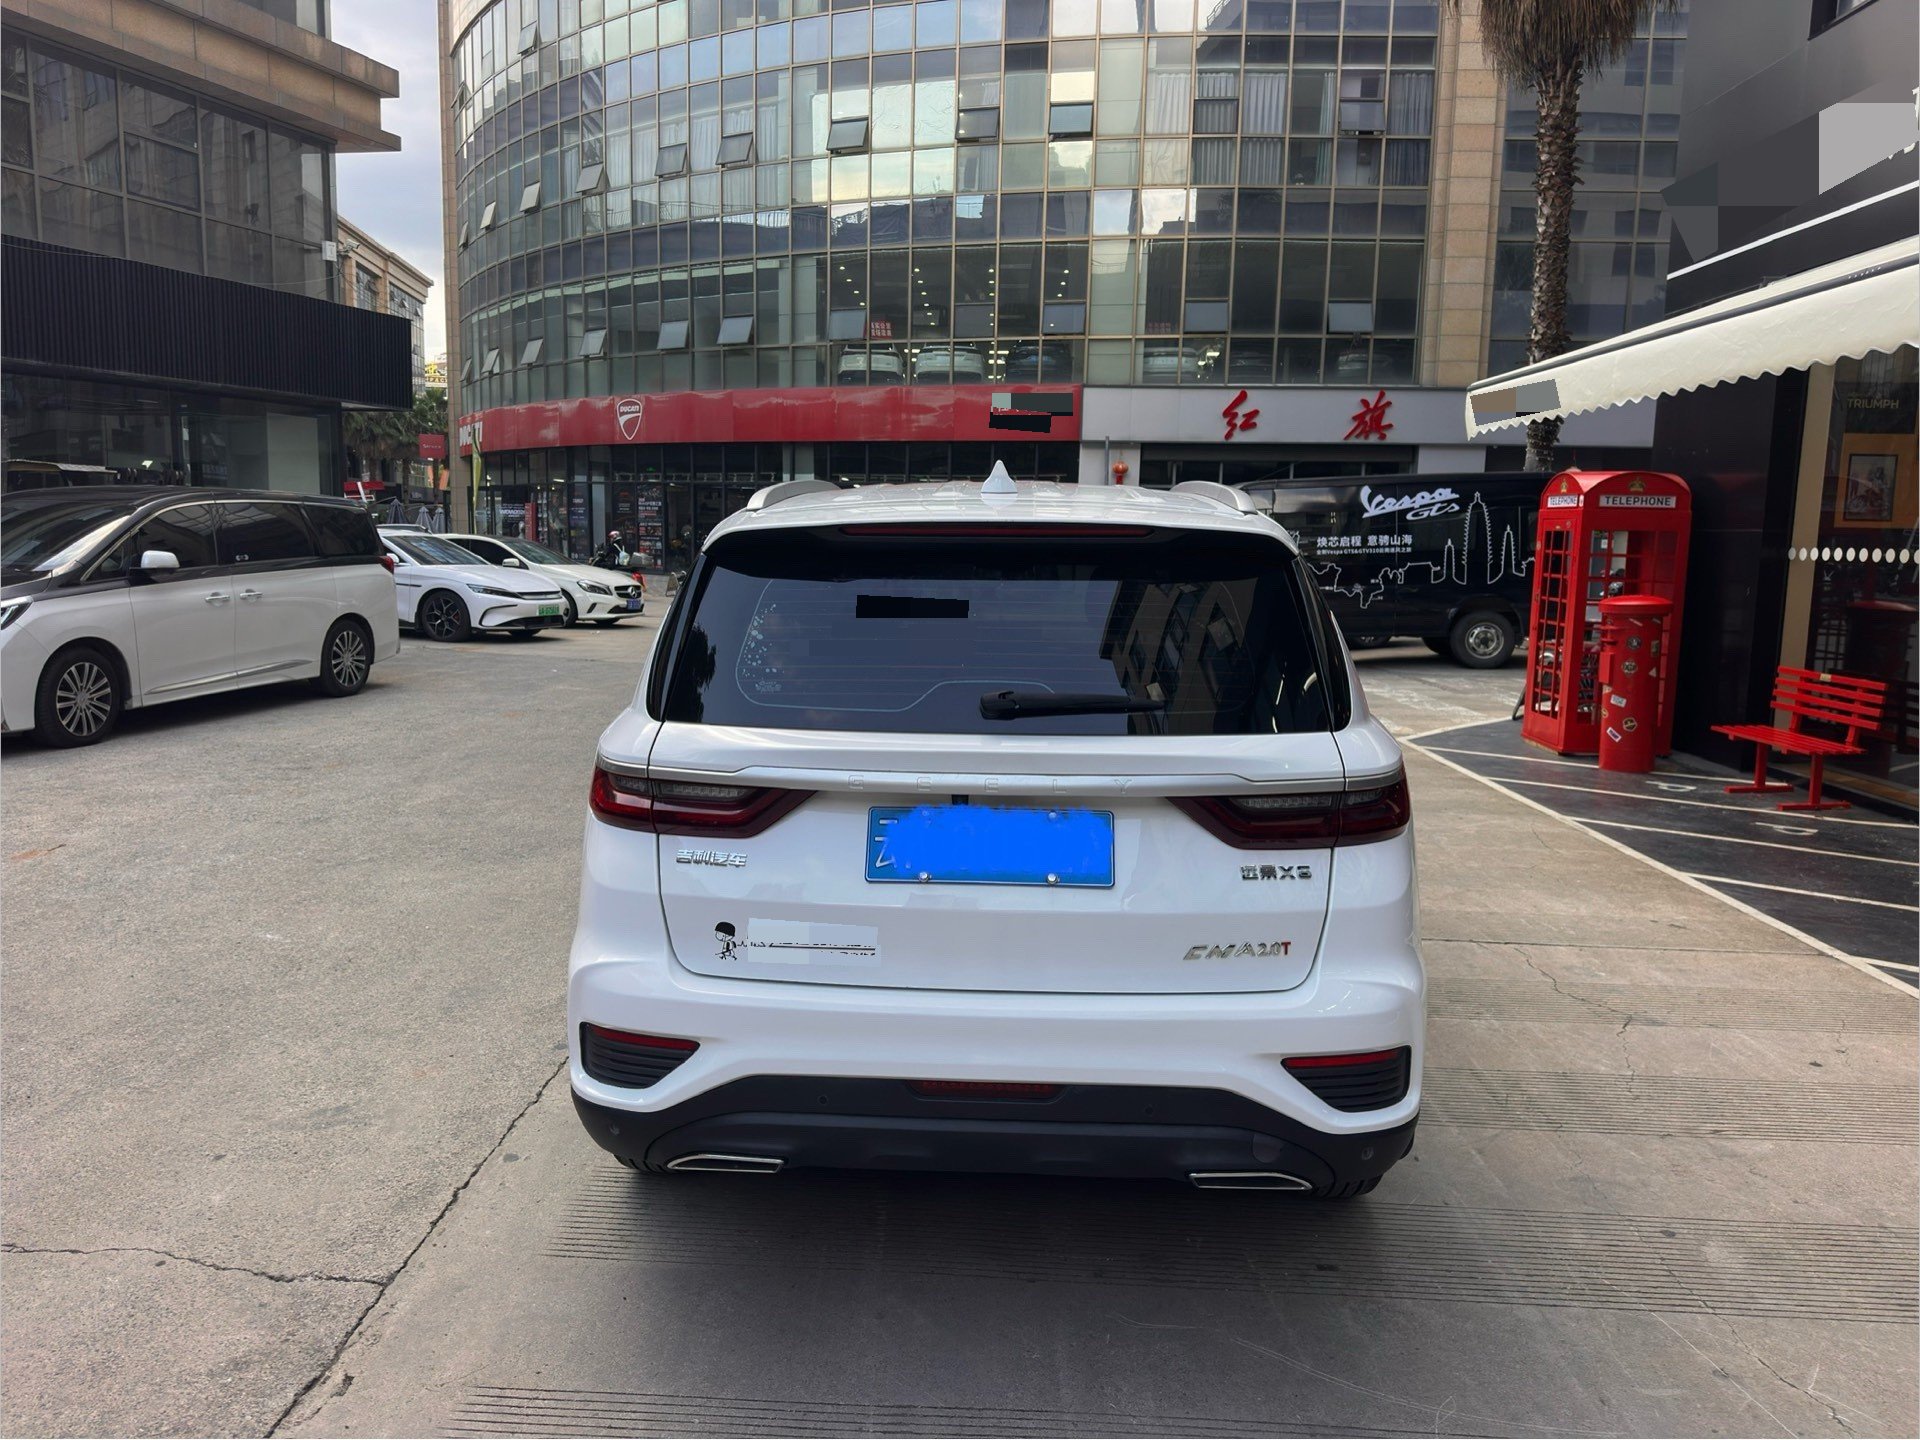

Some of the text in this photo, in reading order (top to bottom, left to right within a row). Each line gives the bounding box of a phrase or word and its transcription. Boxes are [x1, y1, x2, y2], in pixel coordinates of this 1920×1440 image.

[1847, 398, 1900, 409] TRIUMPH
[1222, 389, 1394, 441] 红旗
[1360, 485, 1460, 518] Vespa
[1550, 496, 1578, 506] TELEPHONE
[1604, 496, 1672, 507] TELEPHONE
[848, 774, 1133, 795] GEELY
[676, 849, 749, 867] 吉利汽车
